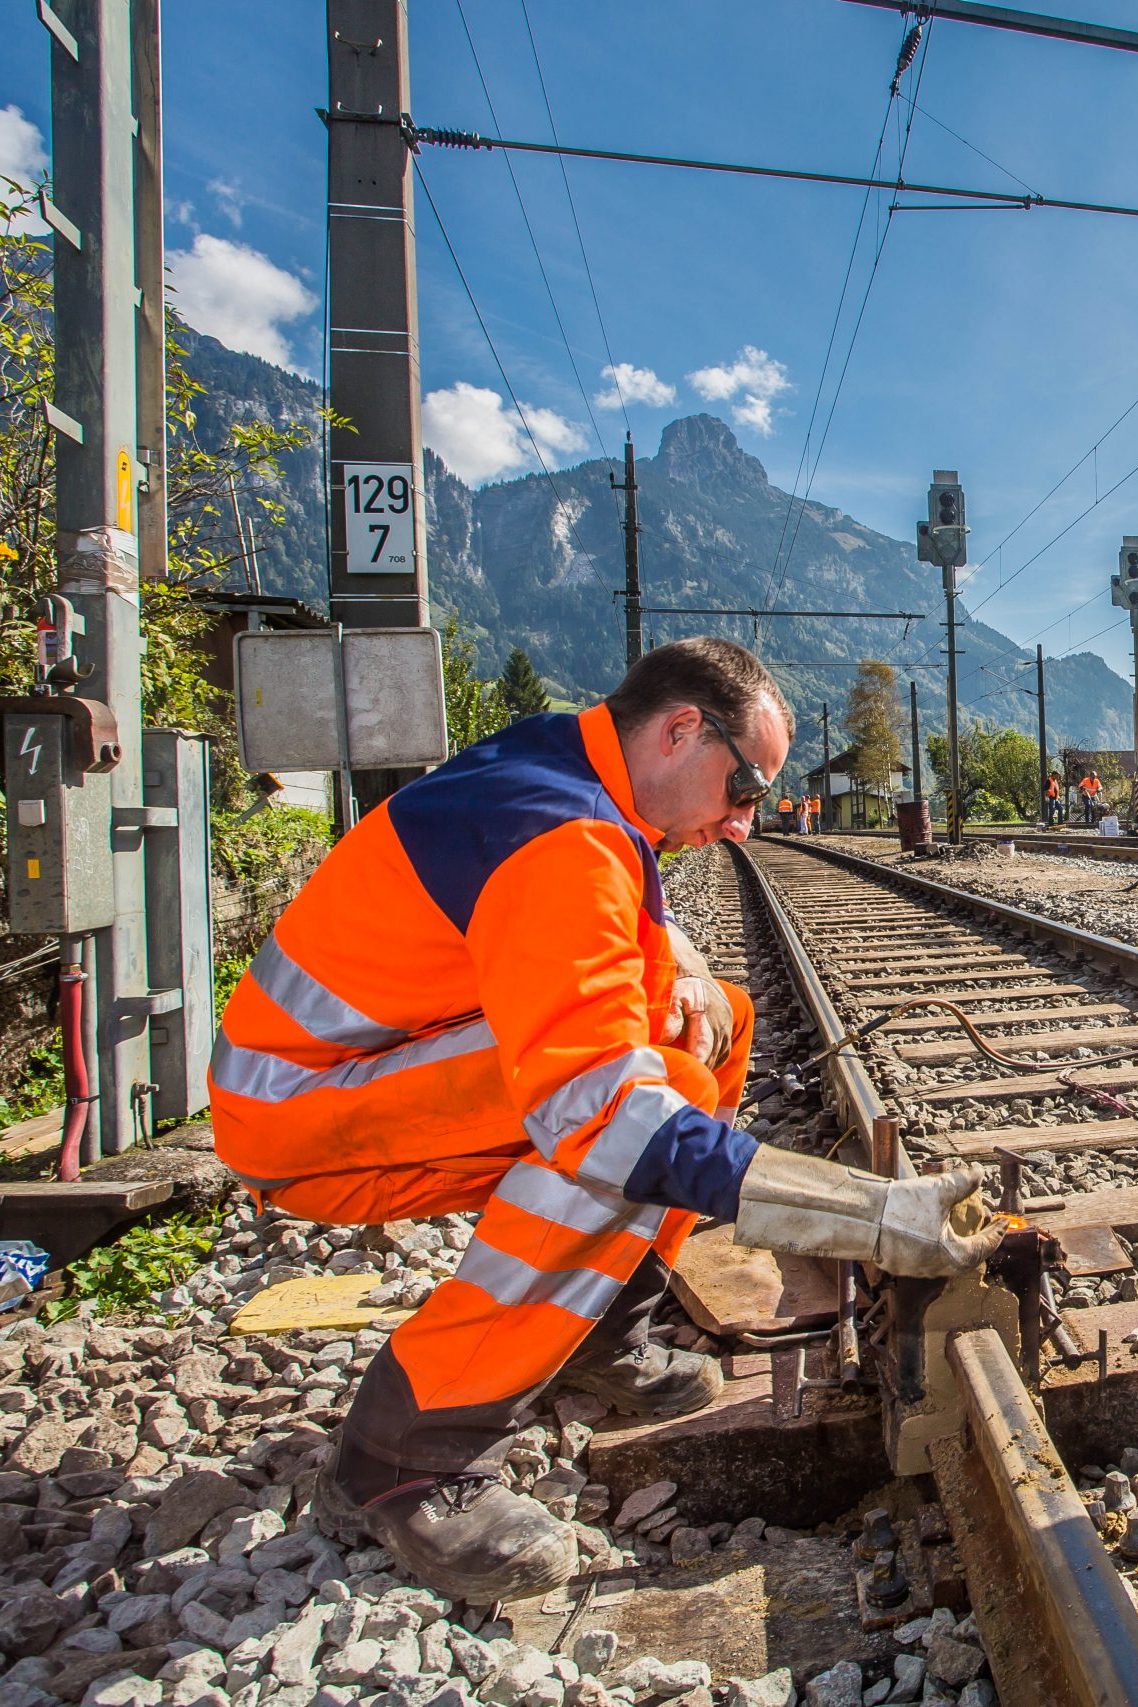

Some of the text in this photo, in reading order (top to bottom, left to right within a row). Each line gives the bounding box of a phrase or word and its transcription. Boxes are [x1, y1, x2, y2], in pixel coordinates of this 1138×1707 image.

[347, 474, 410, 514] 129
[368, 524, 391, 563] 7
[388, 555, 406, 563] 708
[419, 1500, 441, 1523] atlas
